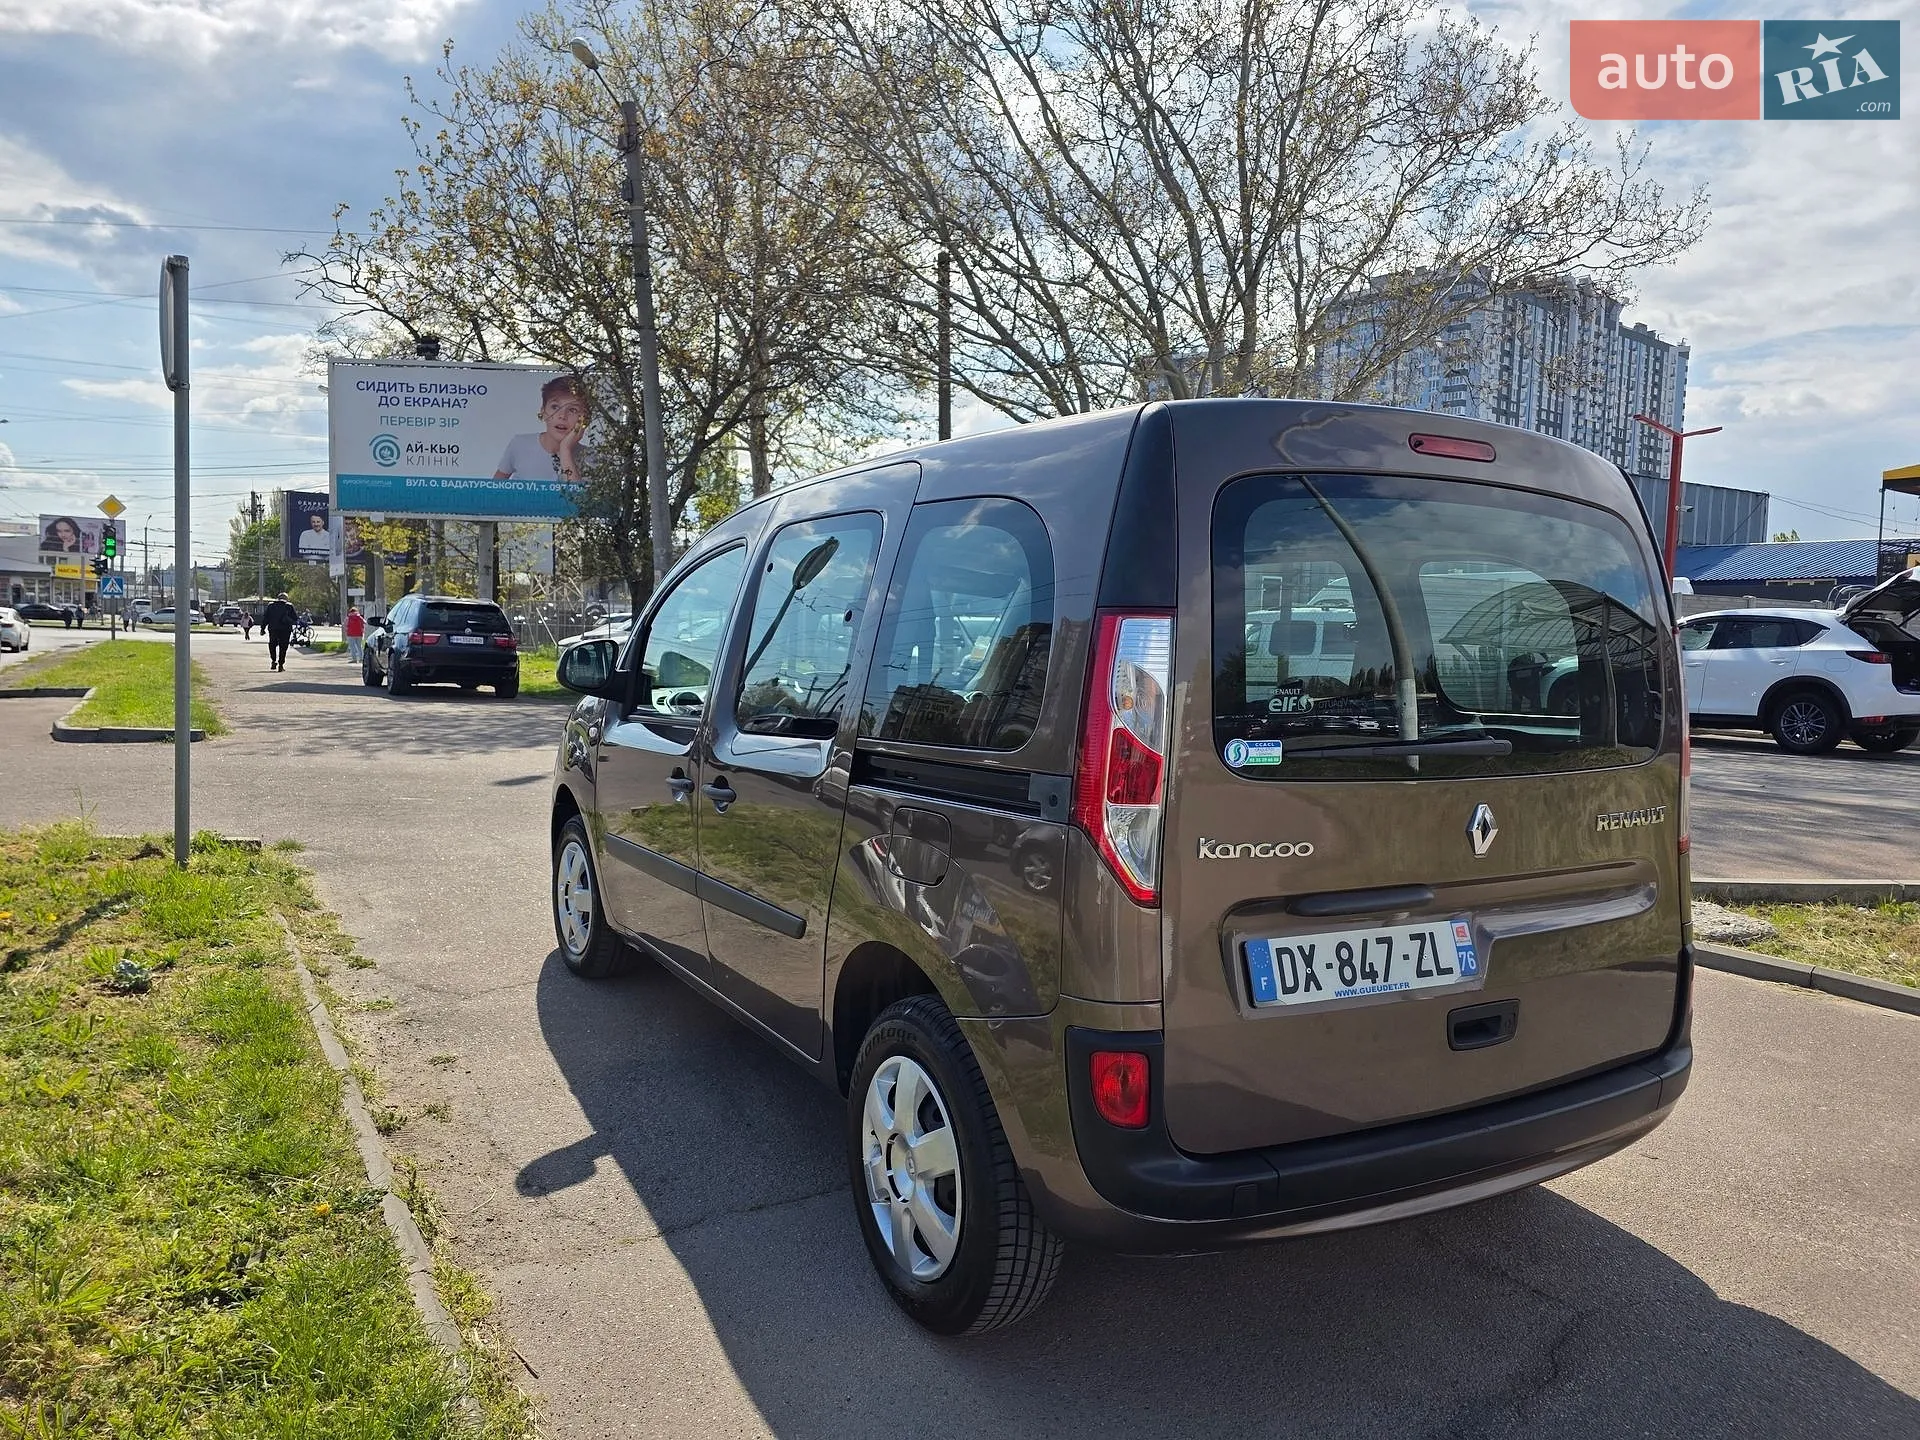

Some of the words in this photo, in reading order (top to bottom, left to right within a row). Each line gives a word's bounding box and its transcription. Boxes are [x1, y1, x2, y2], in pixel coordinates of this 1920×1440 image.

[356, 380, 415, 394] СИДИТЬ
[419, 383, 488, 396] БЛИЗЬКО
[377, 396, 400, 408] ДО
[404, 397, 468, 409] ЕКРАНА?
[379, 415, 436, 428] ПЕРЕВІР
[440, 416, 460, 428] ЗІР
[406, 441, 460, 455] АЙ-КЬЮ
[406, 455, 460, 467] КЛІНІК
[406, 478, 428, 488] ВУЛ.
[441, 479, 524, 491] ВАДАТУРСЬКОГО
[1268, 696, 1298, 712] elf
[1596, 805, 1667, 832] RENAULT
[1198, 837, 1315, 859] Kangoo
[1275, 931, 1454, 996] DX-847-ZL
[1458, 950, 1477, 973] 76
[1260, 976, 1268, 991] F
[1334, 981, 1411, 998] WWW.GUEUDET.FR
